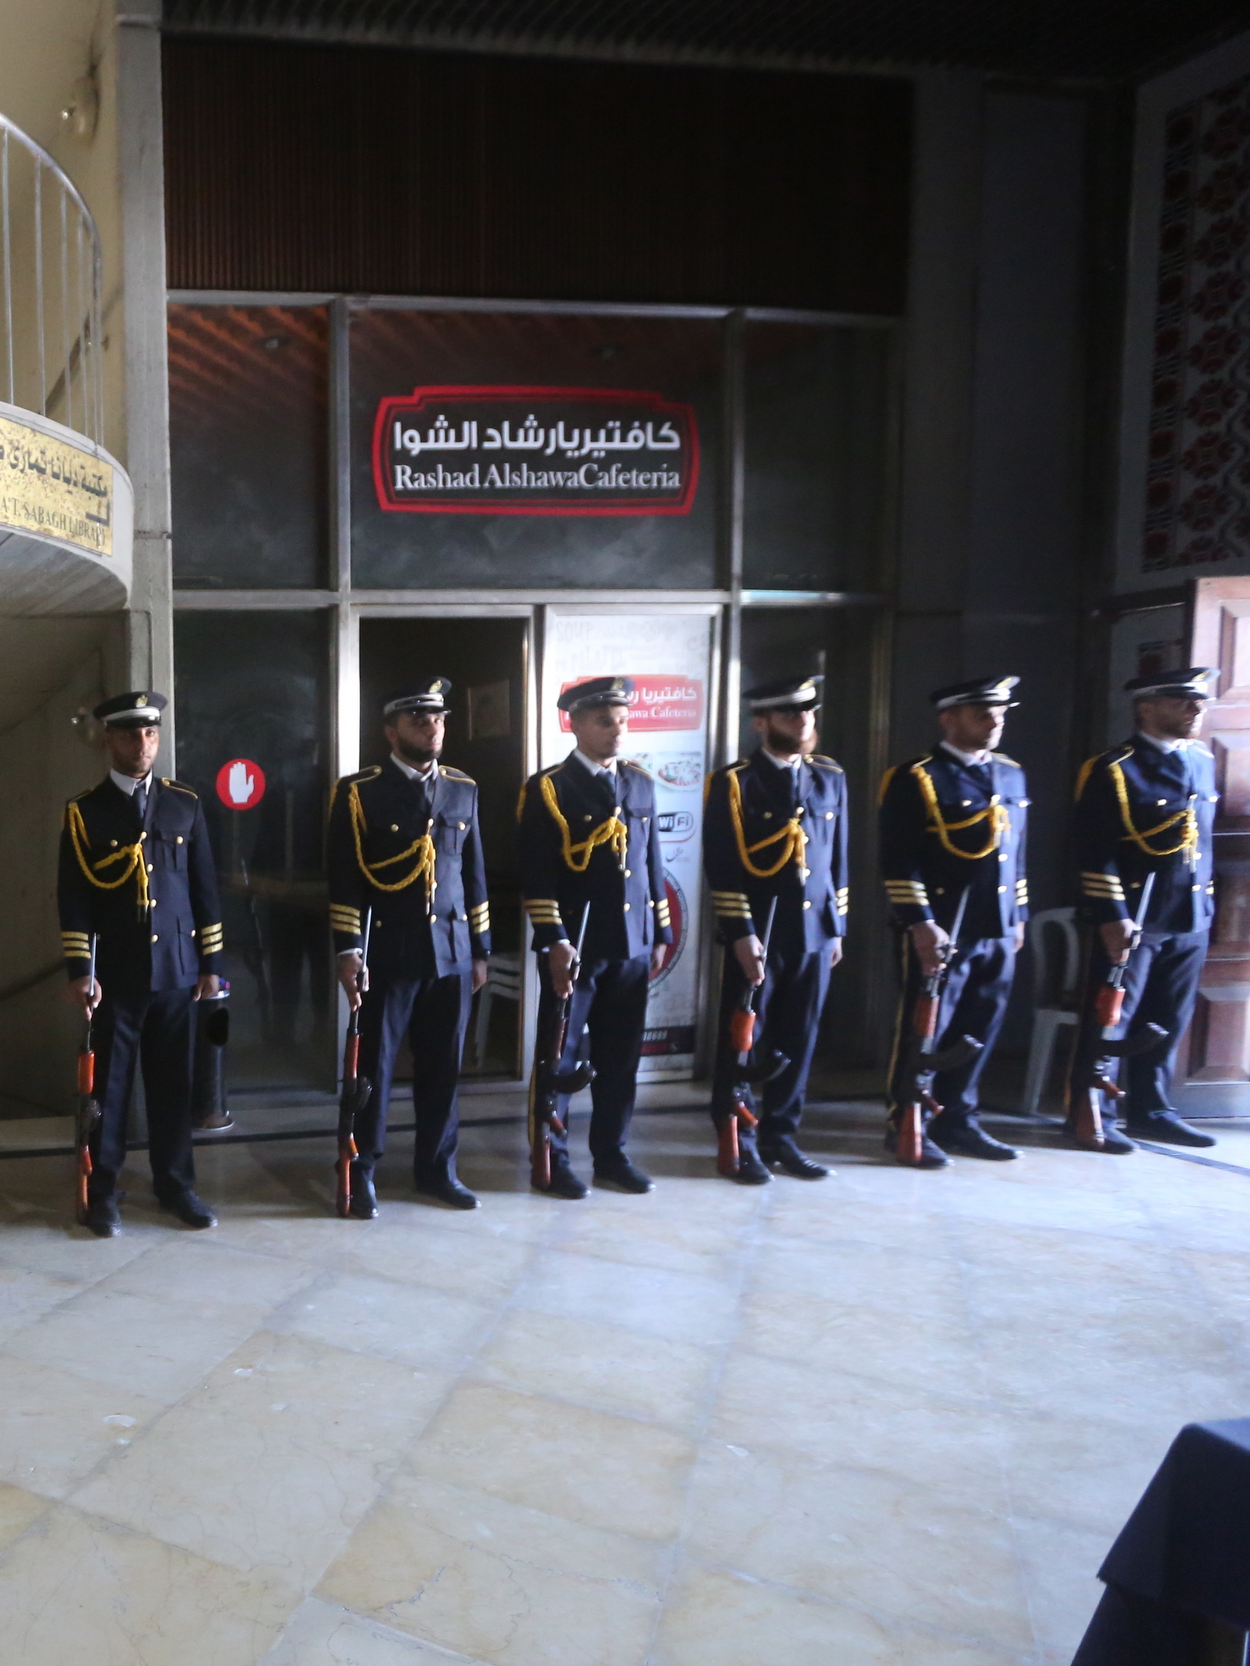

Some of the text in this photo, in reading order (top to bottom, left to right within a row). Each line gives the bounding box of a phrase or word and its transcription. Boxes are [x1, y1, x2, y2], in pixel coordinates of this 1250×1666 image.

[393, 414, 478, 456] الشوا
[394, 463, 480, 490] Rashad
[23, 501, 67, 531] SABAGH
[641, 686, 698, 706] كافتيريا
[650, 706, 697, 718] Cafeteria
